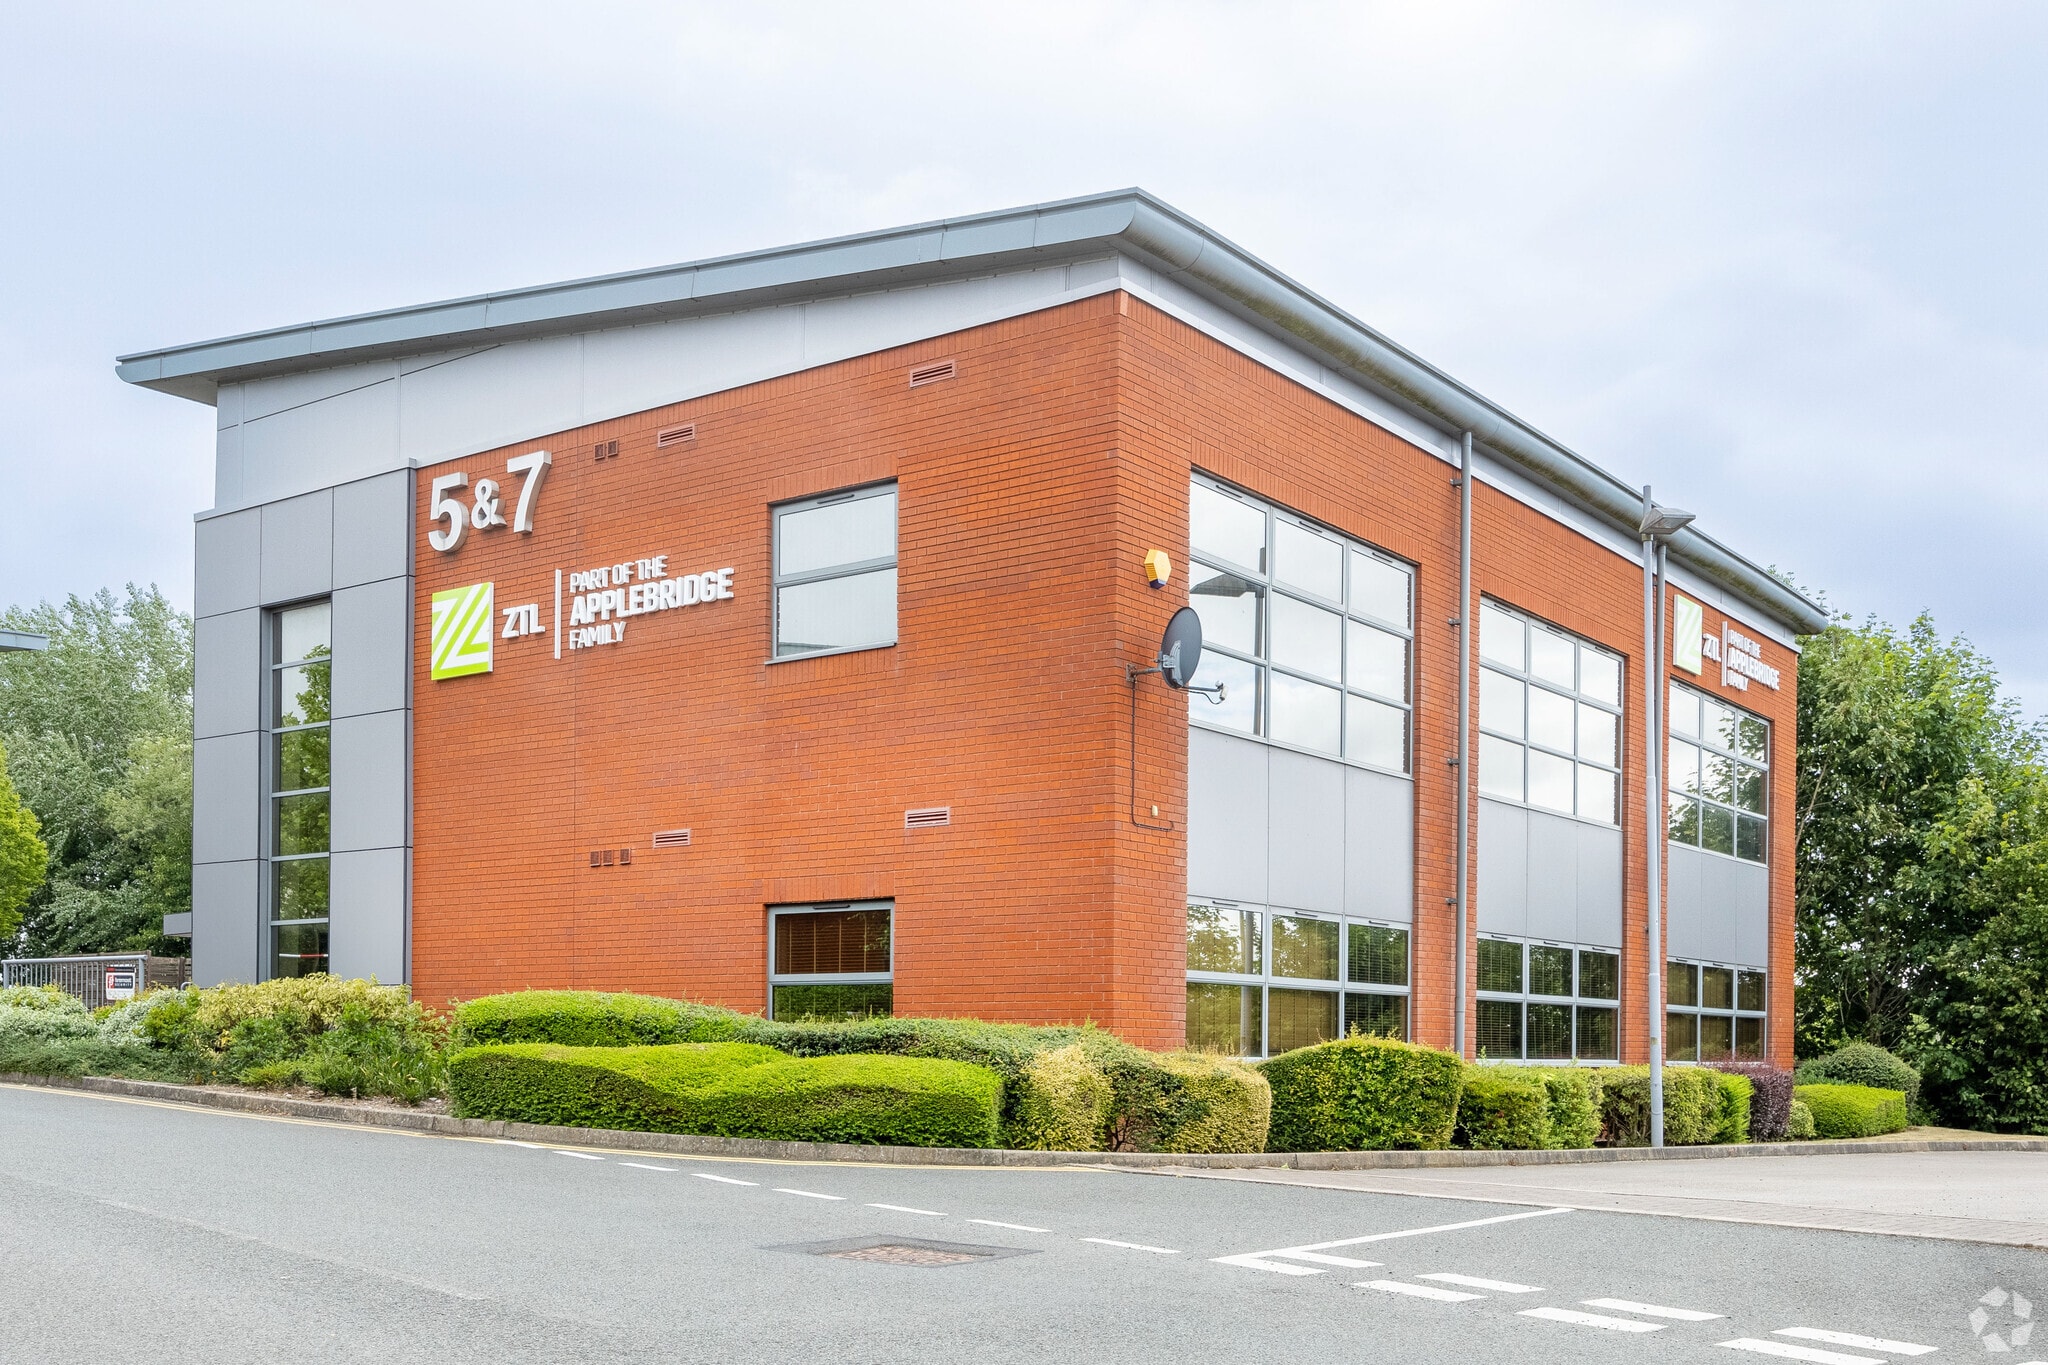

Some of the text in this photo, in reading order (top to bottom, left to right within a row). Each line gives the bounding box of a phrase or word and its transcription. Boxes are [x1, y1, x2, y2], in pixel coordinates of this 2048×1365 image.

[428, 450, 552, 552] 5&7
[569, 555, 668, 593] PART OF THE
[569, 567, 734, 626] APPLEBRIDGE
[501, 604, 546, 639] ZTL
[569, 621, 627, 650] FAMILY
[1703, 633, 1721, 662] ZTL
[1728, 647, 1780, 691] APPLEBRIDGE
